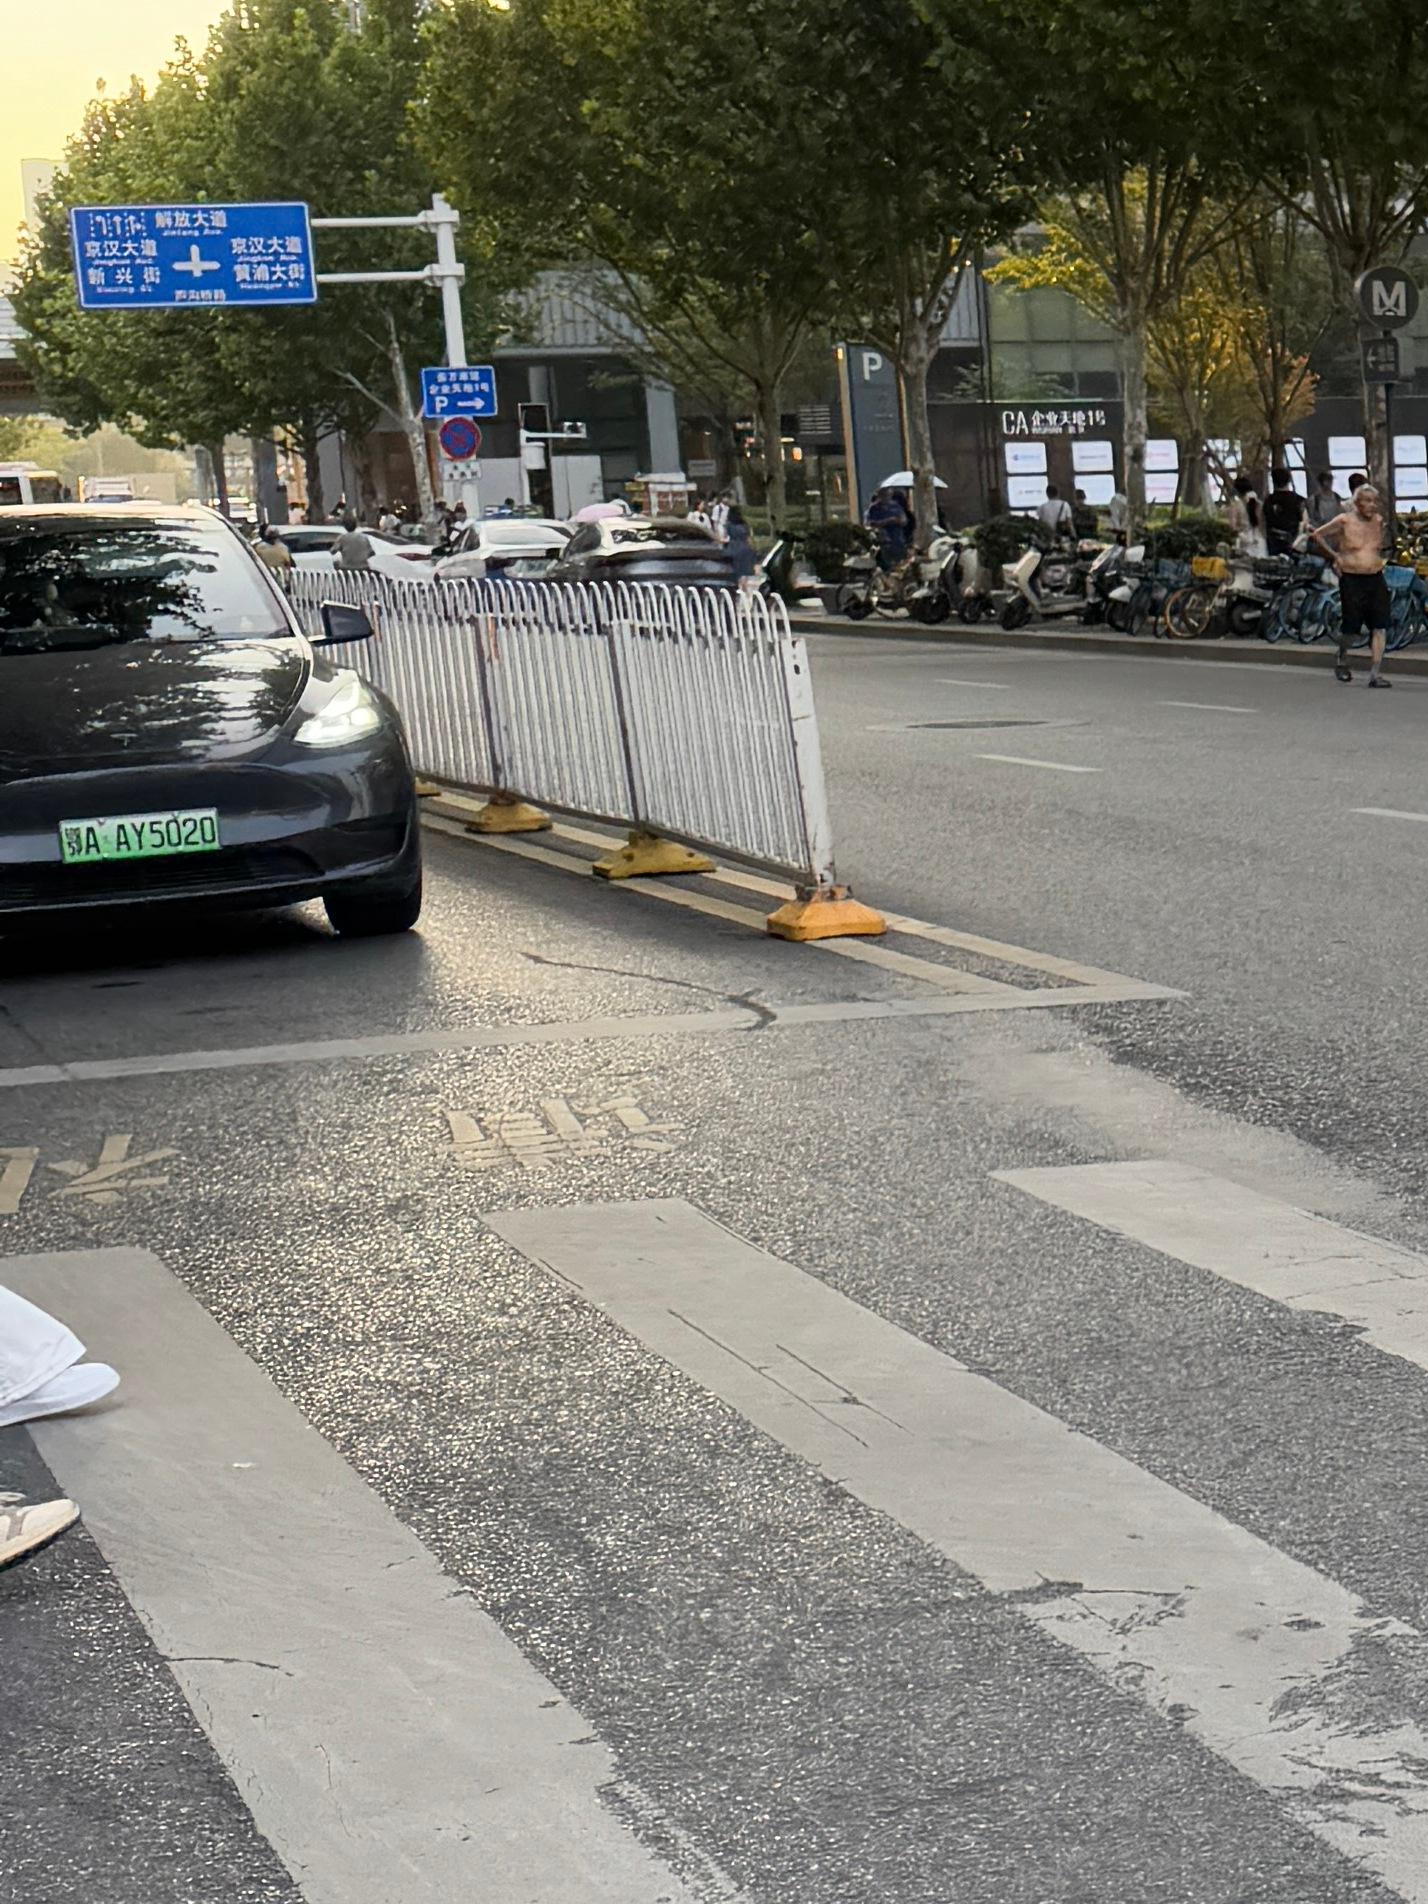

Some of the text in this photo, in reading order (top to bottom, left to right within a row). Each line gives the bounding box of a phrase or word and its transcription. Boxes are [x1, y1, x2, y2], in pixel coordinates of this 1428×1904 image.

[155, 210, 228, 229] 解放大道
[85, 239, 158, 258] 京汉大道
[230, 236, 303, 255] 京汉大道
[233, 263, 305, 283] 黄浦大街
[862, 352, 883, 381] P
[435, 396, 448, 413] P
[1002, 410, 1029, 435] CA
[115, 817, 216, 852] AY5020
